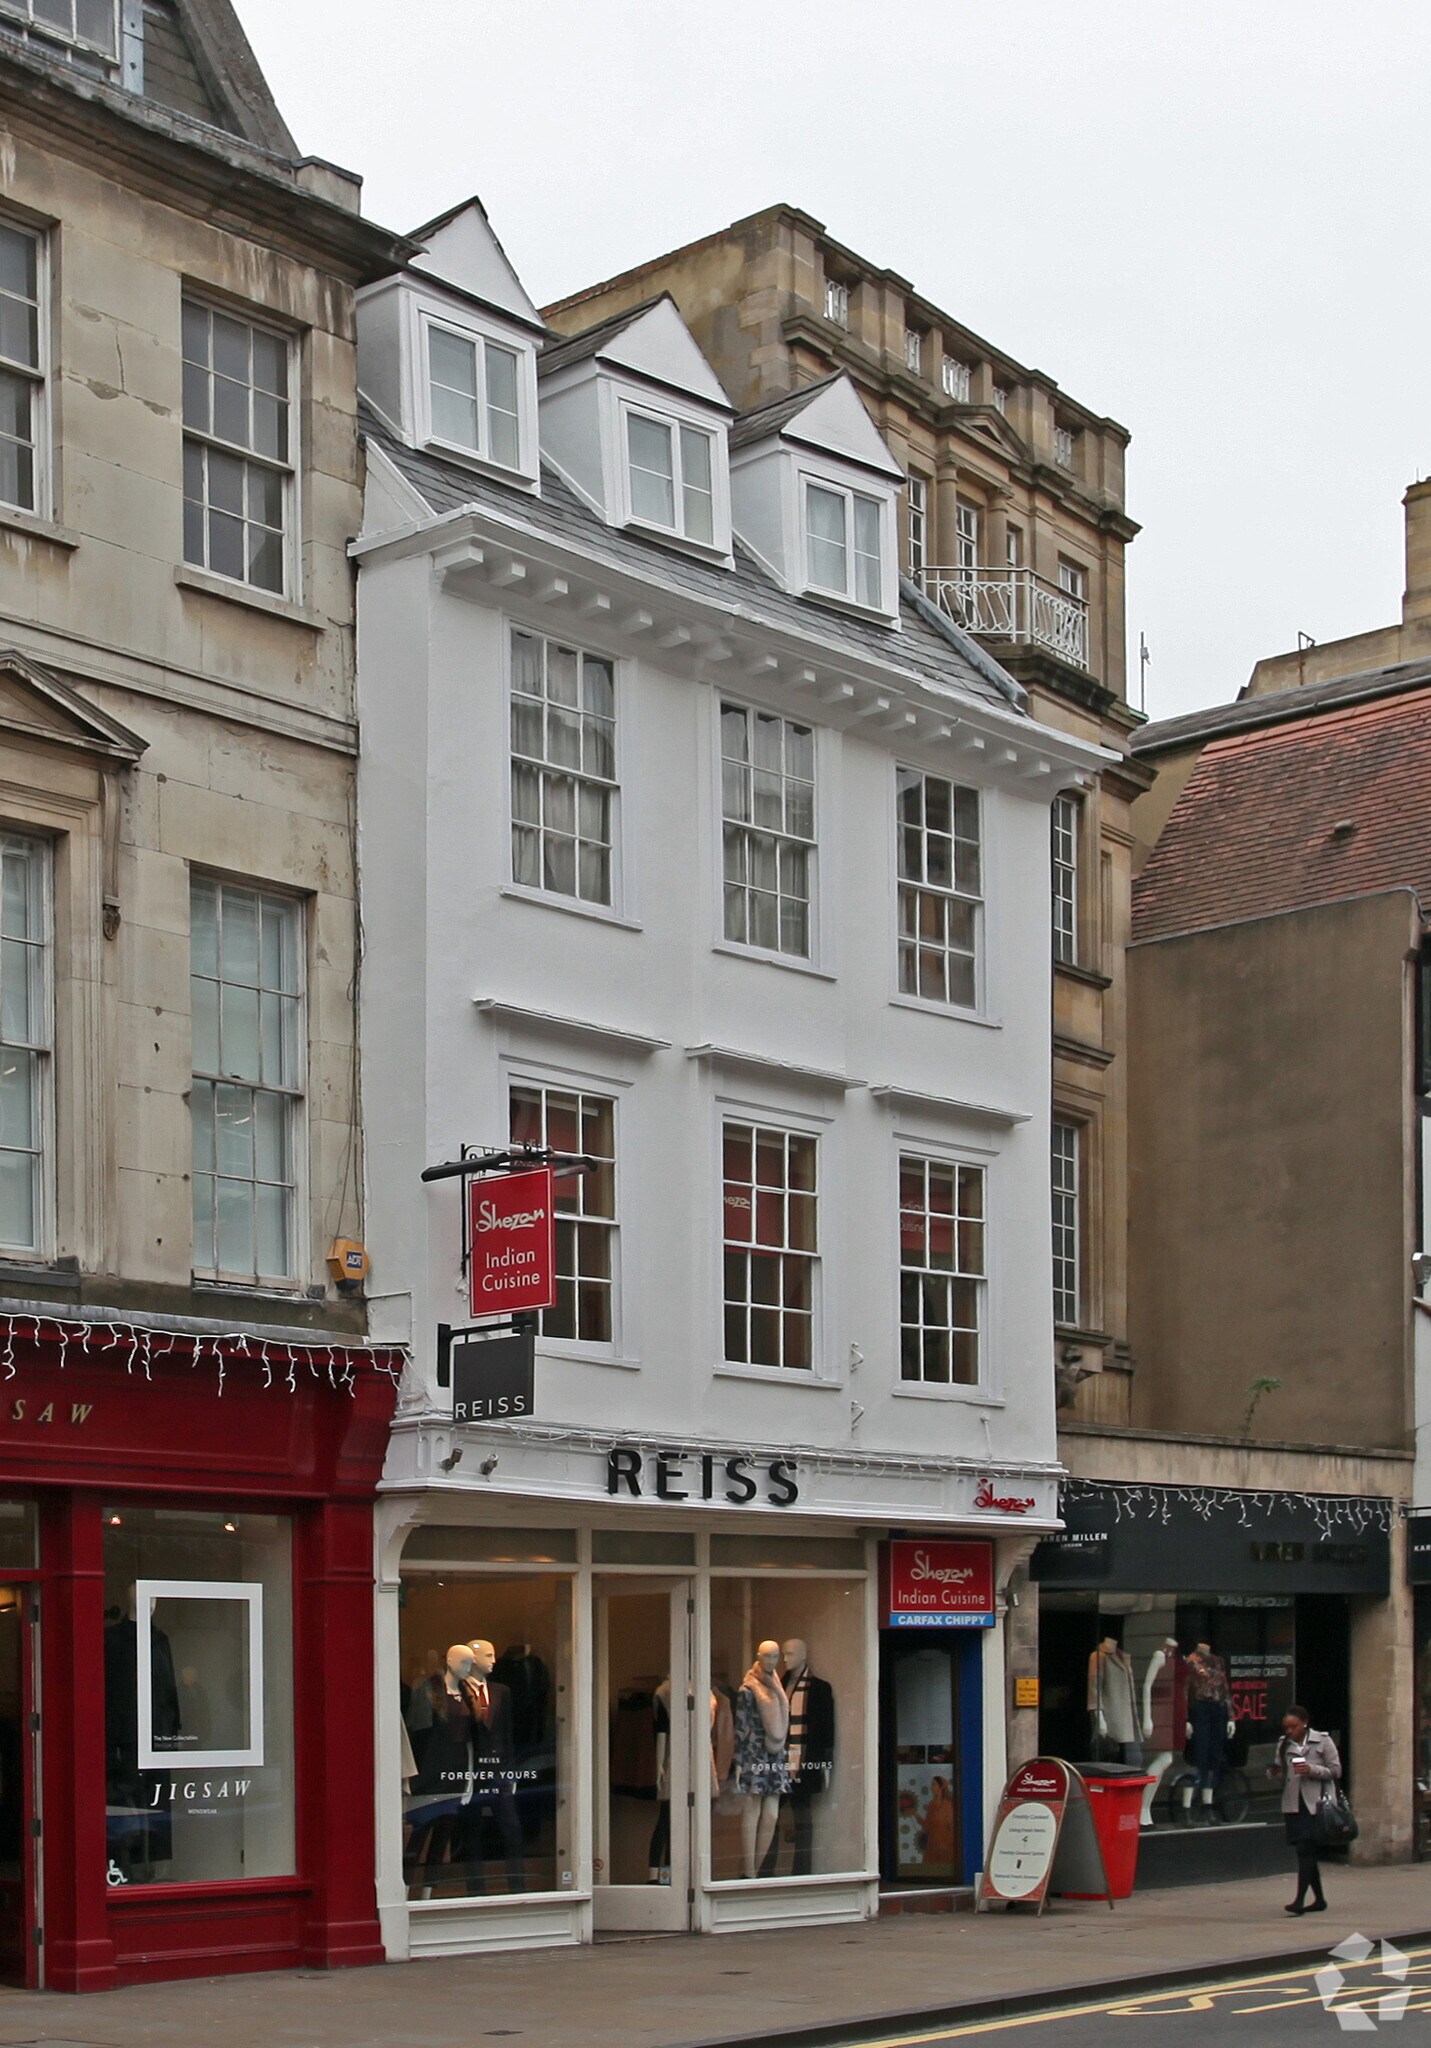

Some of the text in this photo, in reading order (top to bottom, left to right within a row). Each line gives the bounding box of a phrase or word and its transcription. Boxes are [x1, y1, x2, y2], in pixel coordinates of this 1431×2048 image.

[475, 1200, 545, 1232] Shezan
[486, 1247, 536, 1269] Indian
[482, 1270, 540, 1292] Cuisine
[455, 1395, 526, 1419] REISS
[607, 1449, 799, 1505] REISS
[974, 1478, 1036, 1513] Shezan
[1072, 1532, 1108, 1542] MILLEN
[910, 1550, 974, 1584] Shezan
[898, 1588, 986, 1605] Indian Cuisine
[898, 1616, 986, 1625] CARFAX CHIPPY
[1232, 1693, 1267, 1720] SALE
[440, 1770, 538, 1781] FOREVER YOURS
[801, 1761, 833, 1770] YOURS
[150, 1780, 252, 1806] JIGSAW
